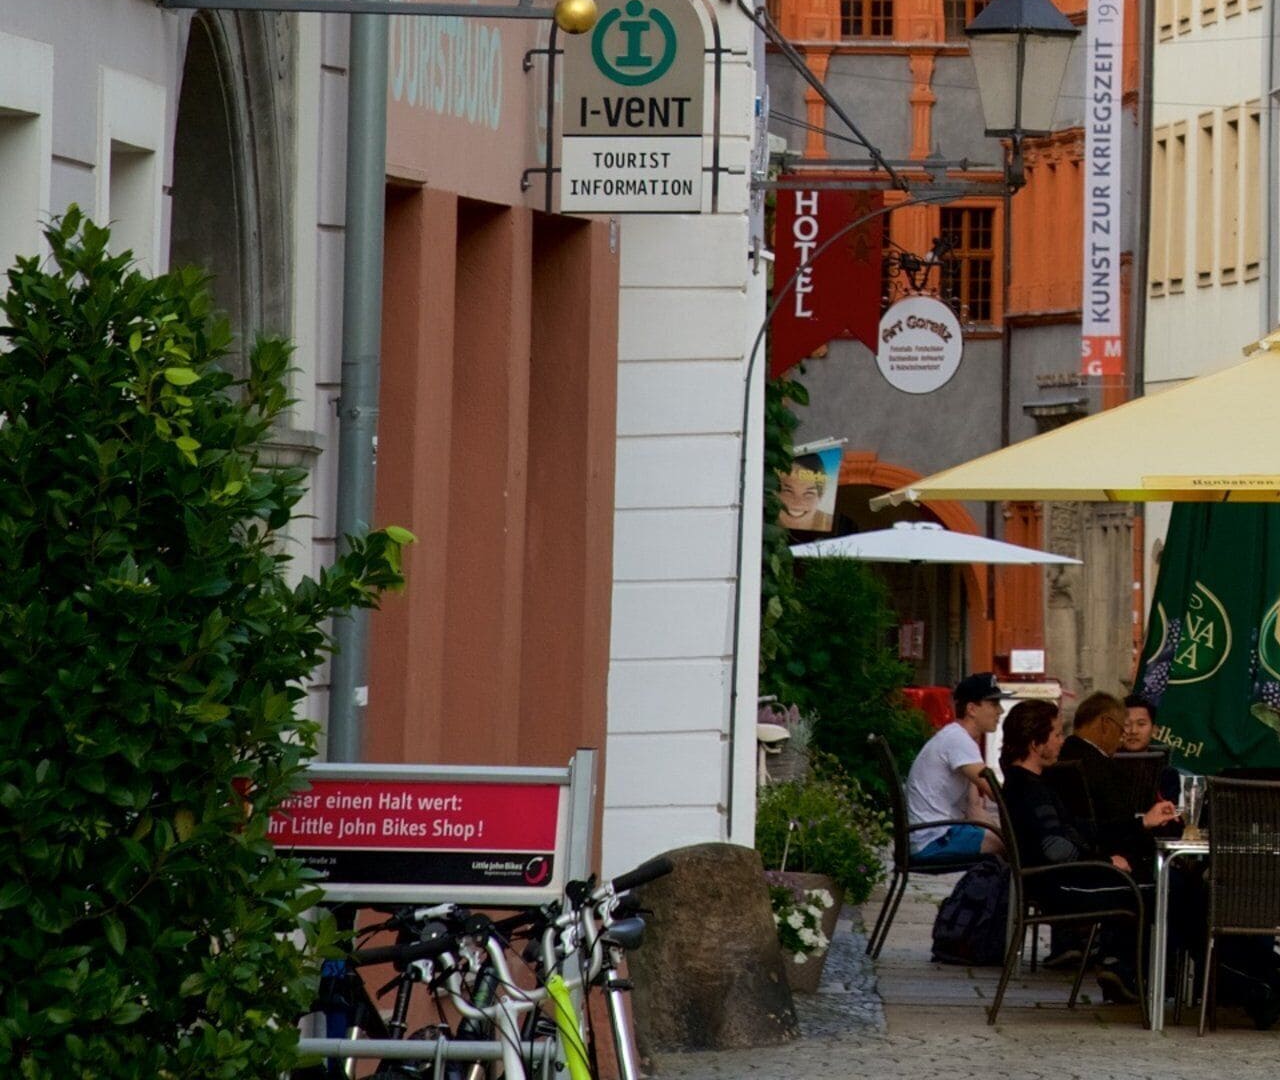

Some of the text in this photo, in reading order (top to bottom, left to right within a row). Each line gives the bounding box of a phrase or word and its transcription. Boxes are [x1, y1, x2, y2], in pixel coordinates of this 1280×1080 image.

[1093, 37, 1114, 180] KRIEGSZEIT
[592, 152, 671, 169] TOURIST
[569, 179, 693, 196] INFORMATION
[1092, 184, 1112, 235] ZUR
[792, 190, 820, 318] HOTEL
[1091, 243, 1112, 323] KUNST
[325, 791, 373, 810] einen
[378, 792, 413, 810] Halt
[417, 793, 463, 812] wert:
[291, 815, 333, 835] Little
[337, 816, 376, 839] John
[381, 818, 428, 837] Bikes
